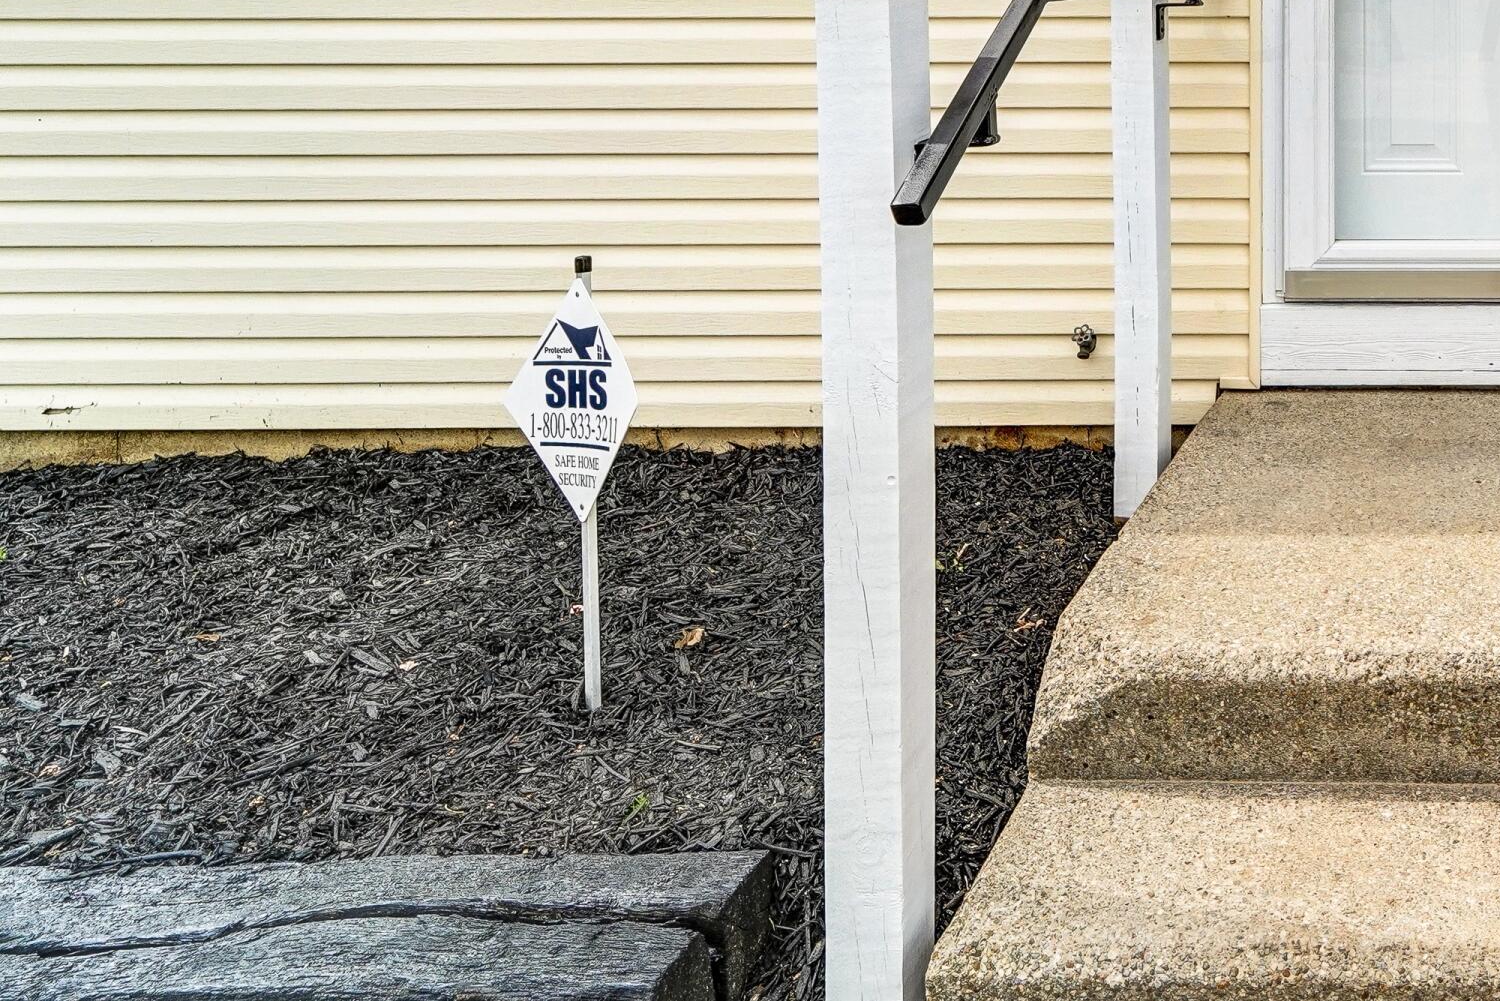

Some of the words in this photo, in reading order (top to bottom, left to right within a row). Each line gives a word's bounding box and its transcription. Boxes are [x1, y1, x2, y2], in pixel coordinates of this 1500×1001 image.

[544, 346, 573, 354] Protected
[545, 368, 608, 411] SHS
[530, 412, 618, 444] 1-800-833-3211
[555, 454, 577, 468] SAFE
[577, 455, 600, 471] HOME
[558, 472, 597, 489] SECURITY
